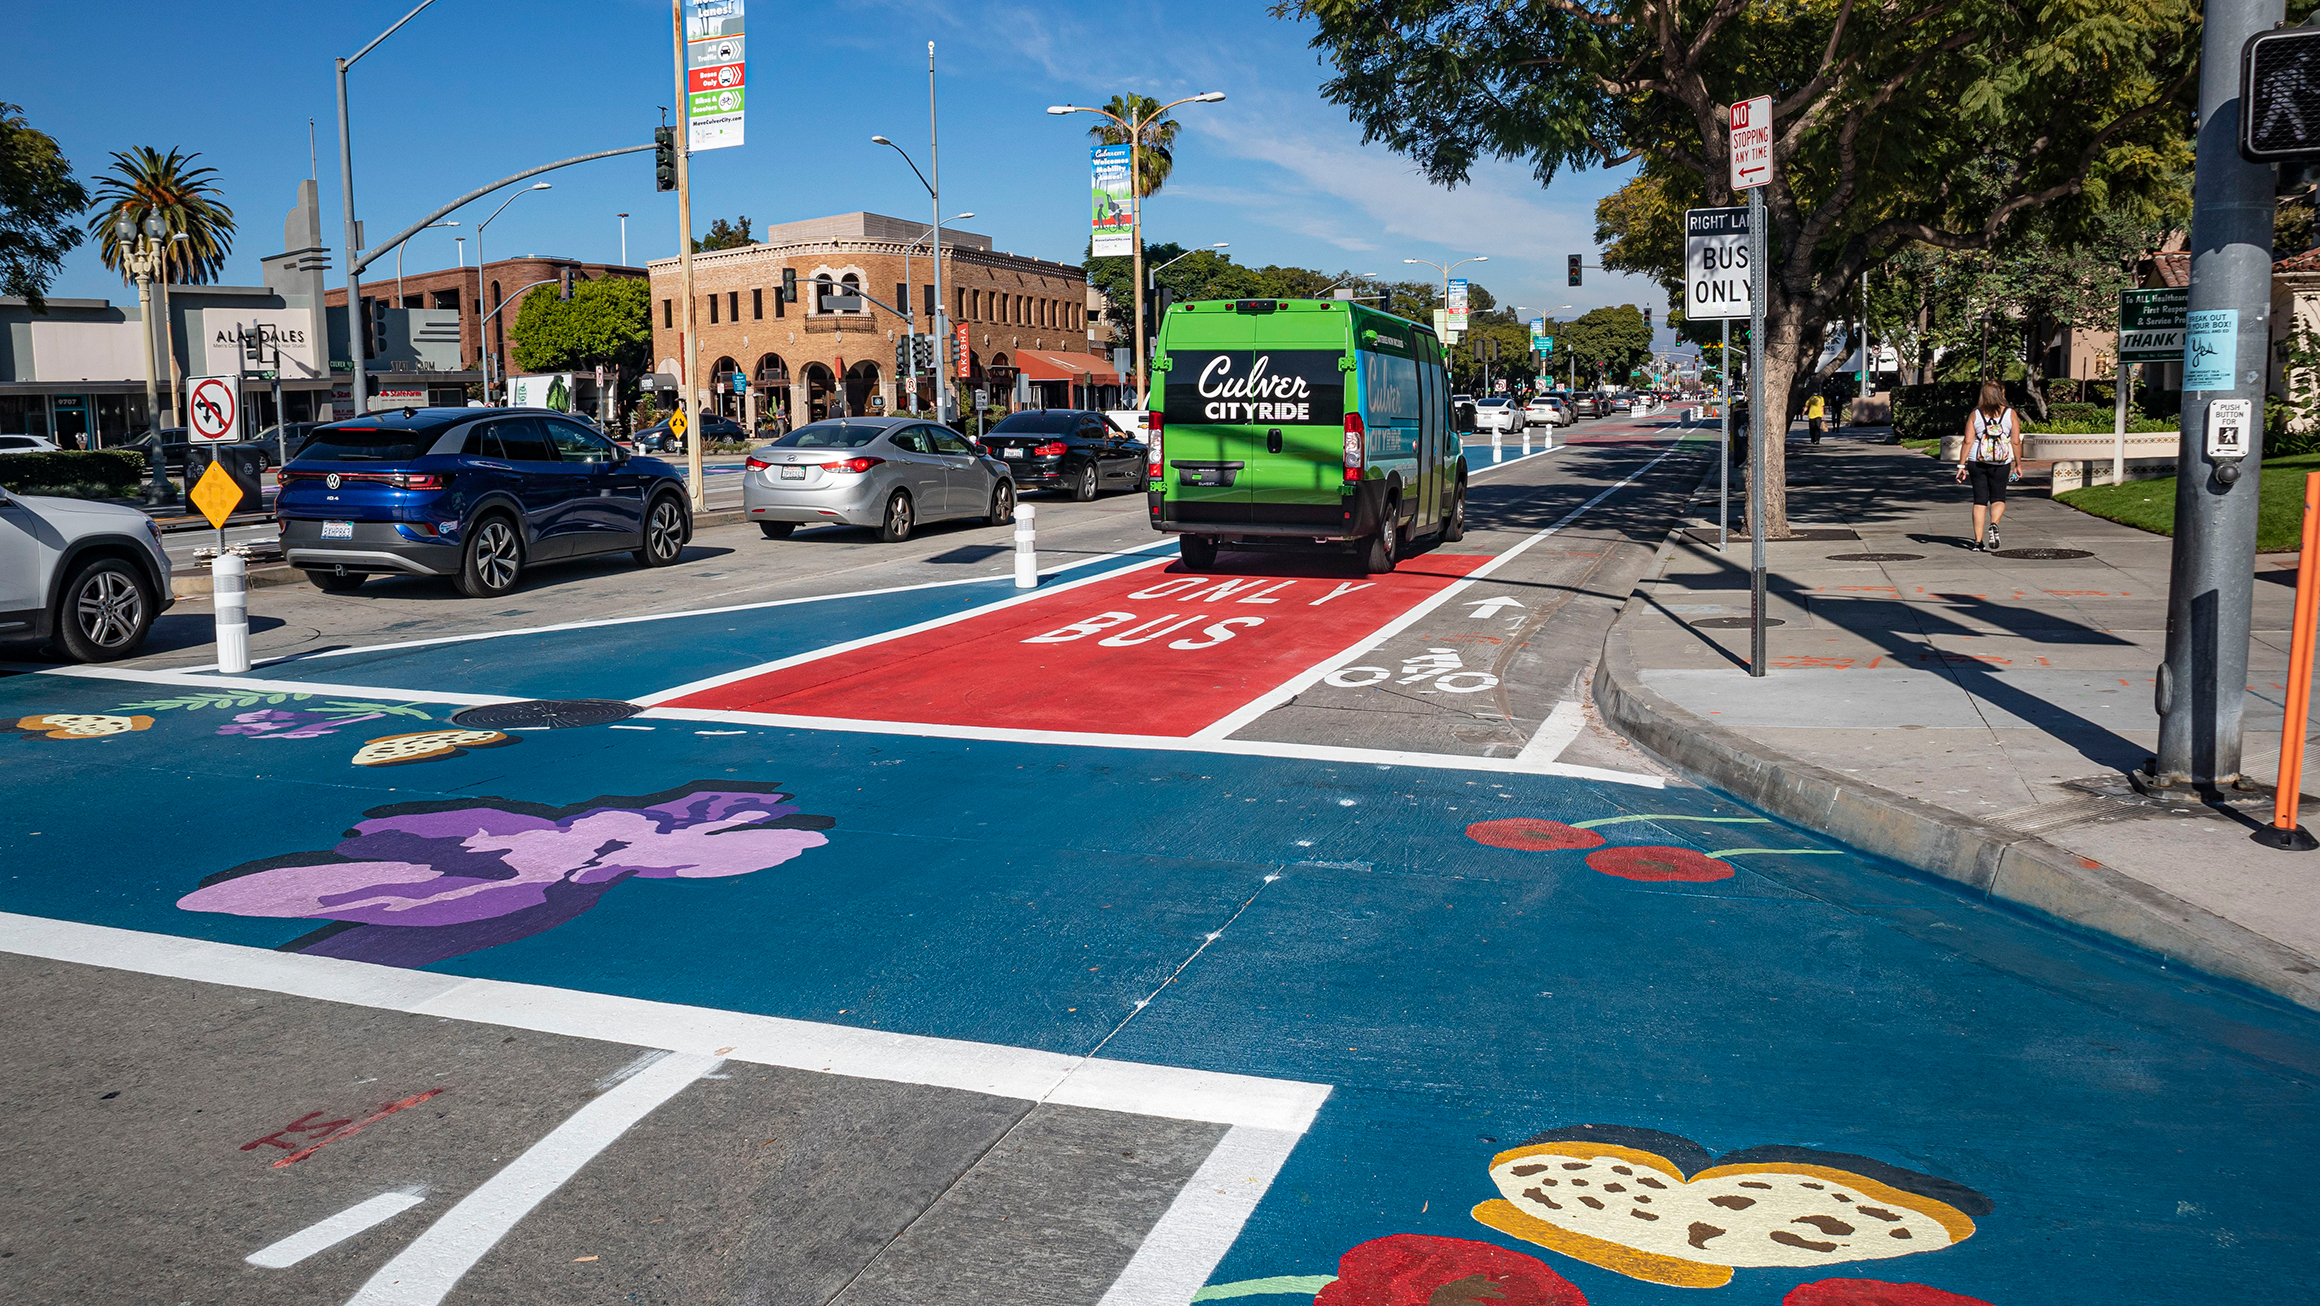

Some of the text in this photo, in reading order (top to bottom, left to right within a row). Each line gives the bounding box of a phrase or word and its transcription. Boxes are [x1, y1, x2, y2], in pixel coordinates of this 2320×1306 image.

[698, 2, 733, 18] Lanes!
[697, 53, 717, 62] Traffic
[703, 79, 718, 87] Only
[693, 116, 742, 126] MoveCulverCity.com
[1732, 104, 1748, 127] NO
[1733, 126, 1768, 149] STOPPING
[1092, 158, 1129, 166] Welcomes
[1735, 148, 1767, 164] ANY TIME
[1096, 165, 1126, 173] Mobility
[1690, 213, 1750, 231] RIGHT LA
[1703, 246, 1748, 270] BUS
[2125, 296, 2133, 304] To
[2136, 295, 2150, 303] ALL
[2143, 305, 2188, 314] First Respon
[2146, 317, 2171, 325] Service
[2174, 316, 2187, 324] Pro
[216, 330, 304, 343] ALADALES
[2124, 332, 2178, 348] THANK
[960, 328, 968, 373] AKASHA
[1198, 355, 1311, 399] Culver
[1368, 355, 1402, 414] Culver
[1205, 402, 1310, 420] CITYRIDE
[1127, 577, 1377, 606] ONLY
[1019, 611, 1266, 650] BUS
[239, 1111, 353, 1151] TS
